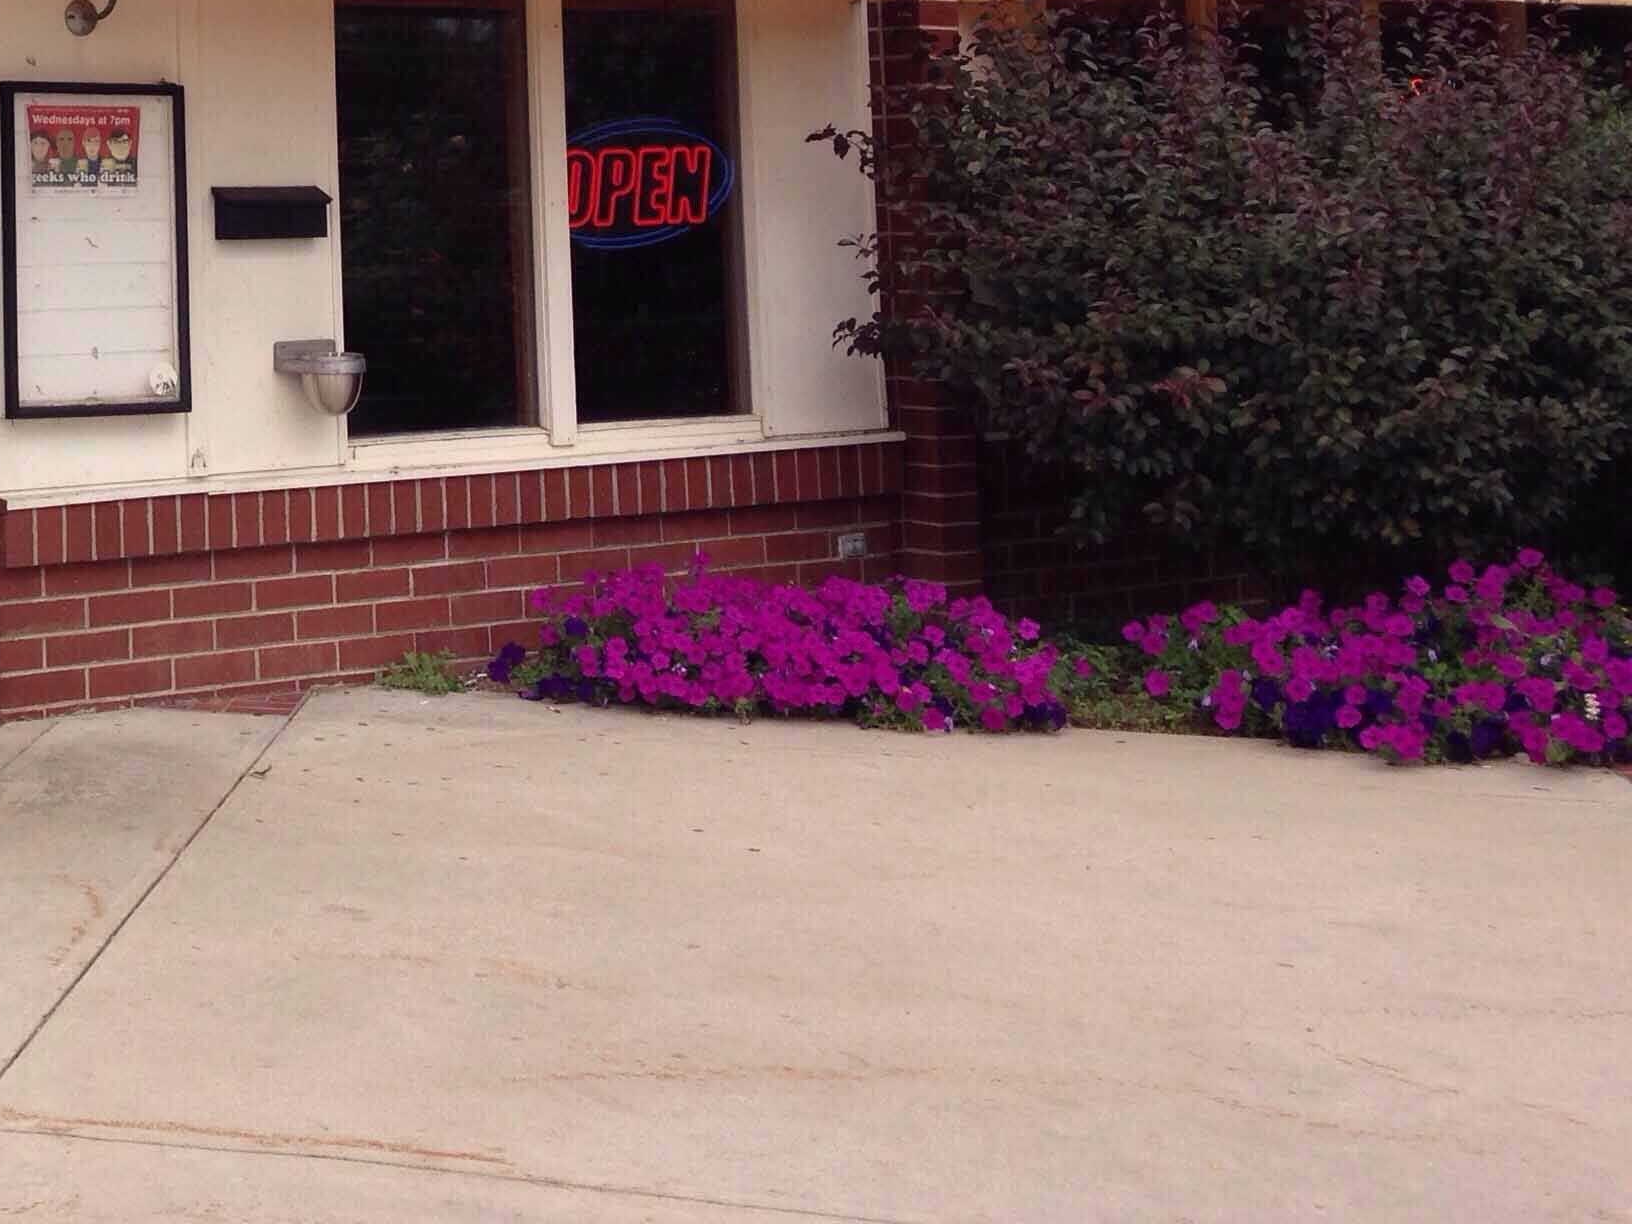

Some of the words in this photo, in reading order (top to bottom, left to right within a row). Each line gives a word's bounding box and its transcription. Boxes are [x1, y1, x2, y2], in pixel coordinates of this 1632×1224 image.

[31, 114, 96, 126] Wednesdays
[98, 116, 107, 125] at
[110, 115, 131, 127] 7pm
[67, 172, 97, 183] who
[101, 172, 137, 183] drink
[565, 145, 712, 228] OPEN
